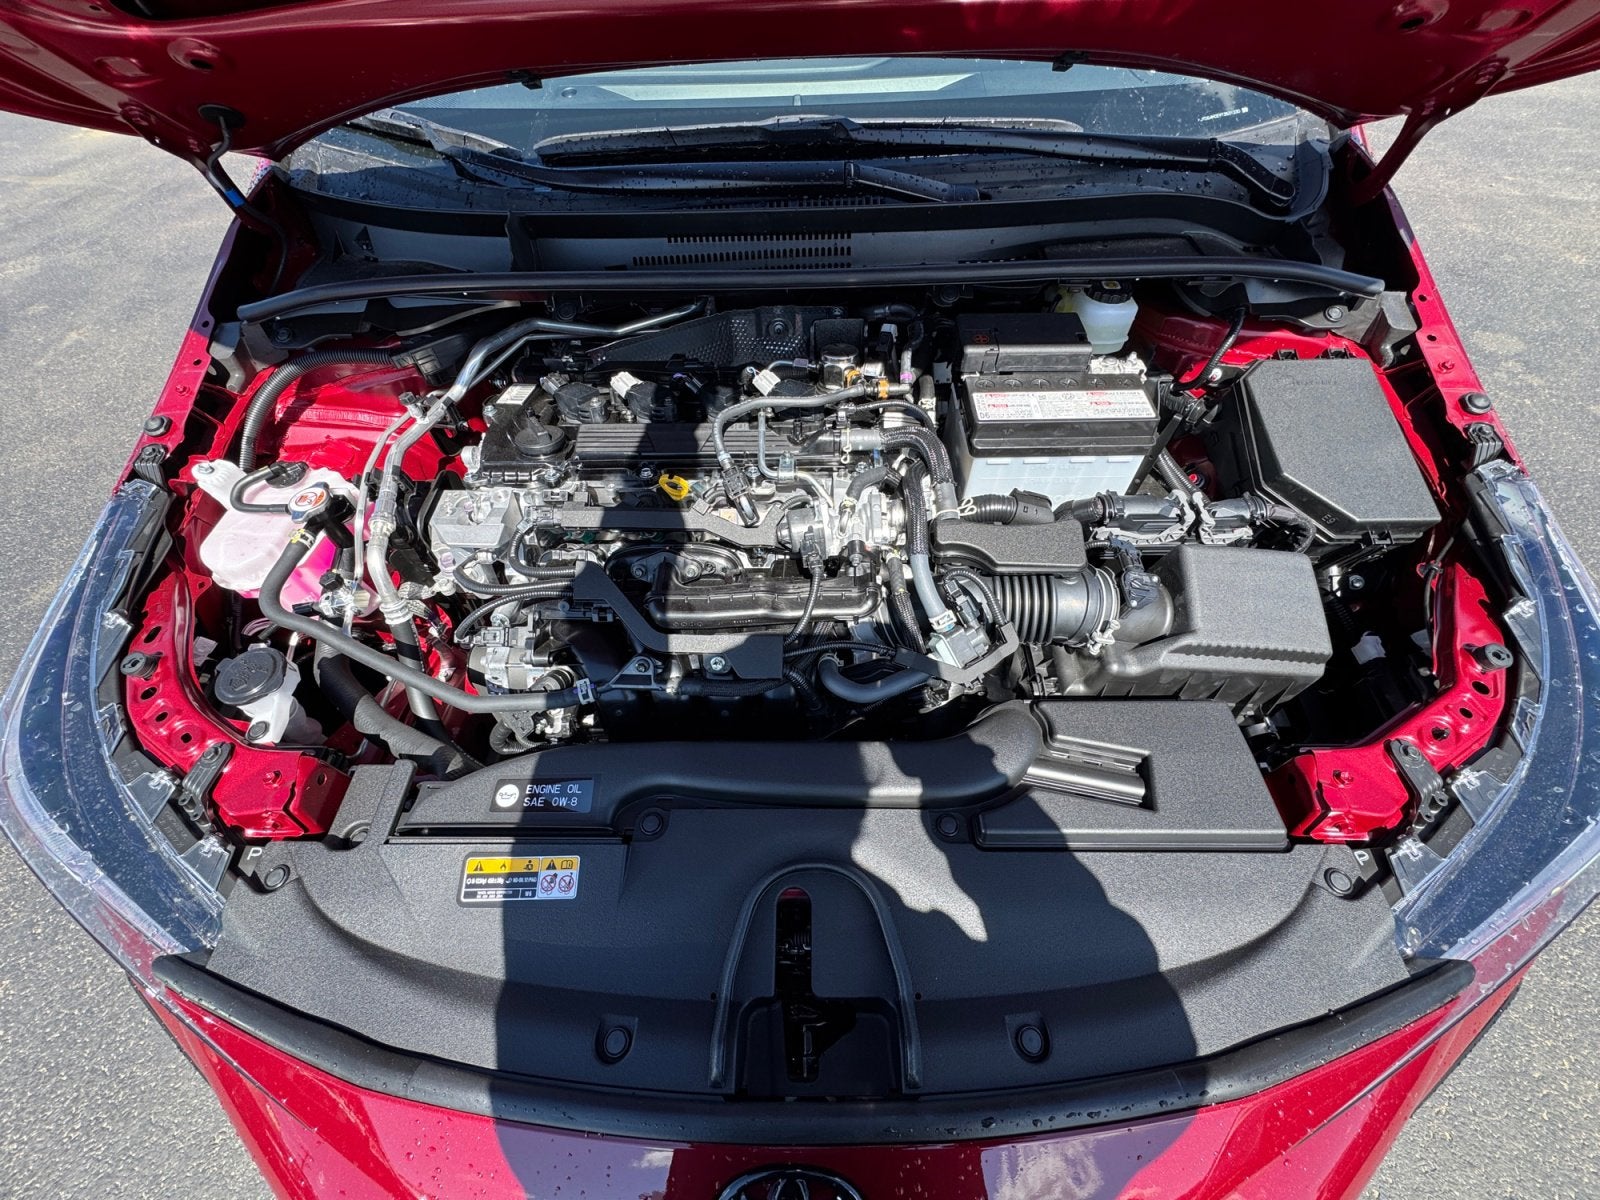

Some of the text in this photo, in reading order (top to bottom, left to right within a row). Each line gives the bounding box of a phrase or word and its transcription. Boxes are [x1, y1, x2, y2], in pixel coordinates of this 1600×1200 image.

[525, 783, 582, 794] ENGINE OIL
[523, 797, 545, 807] SAE
[246, 847, 263, 860] P
[1353, 850, 1370, 866] P
